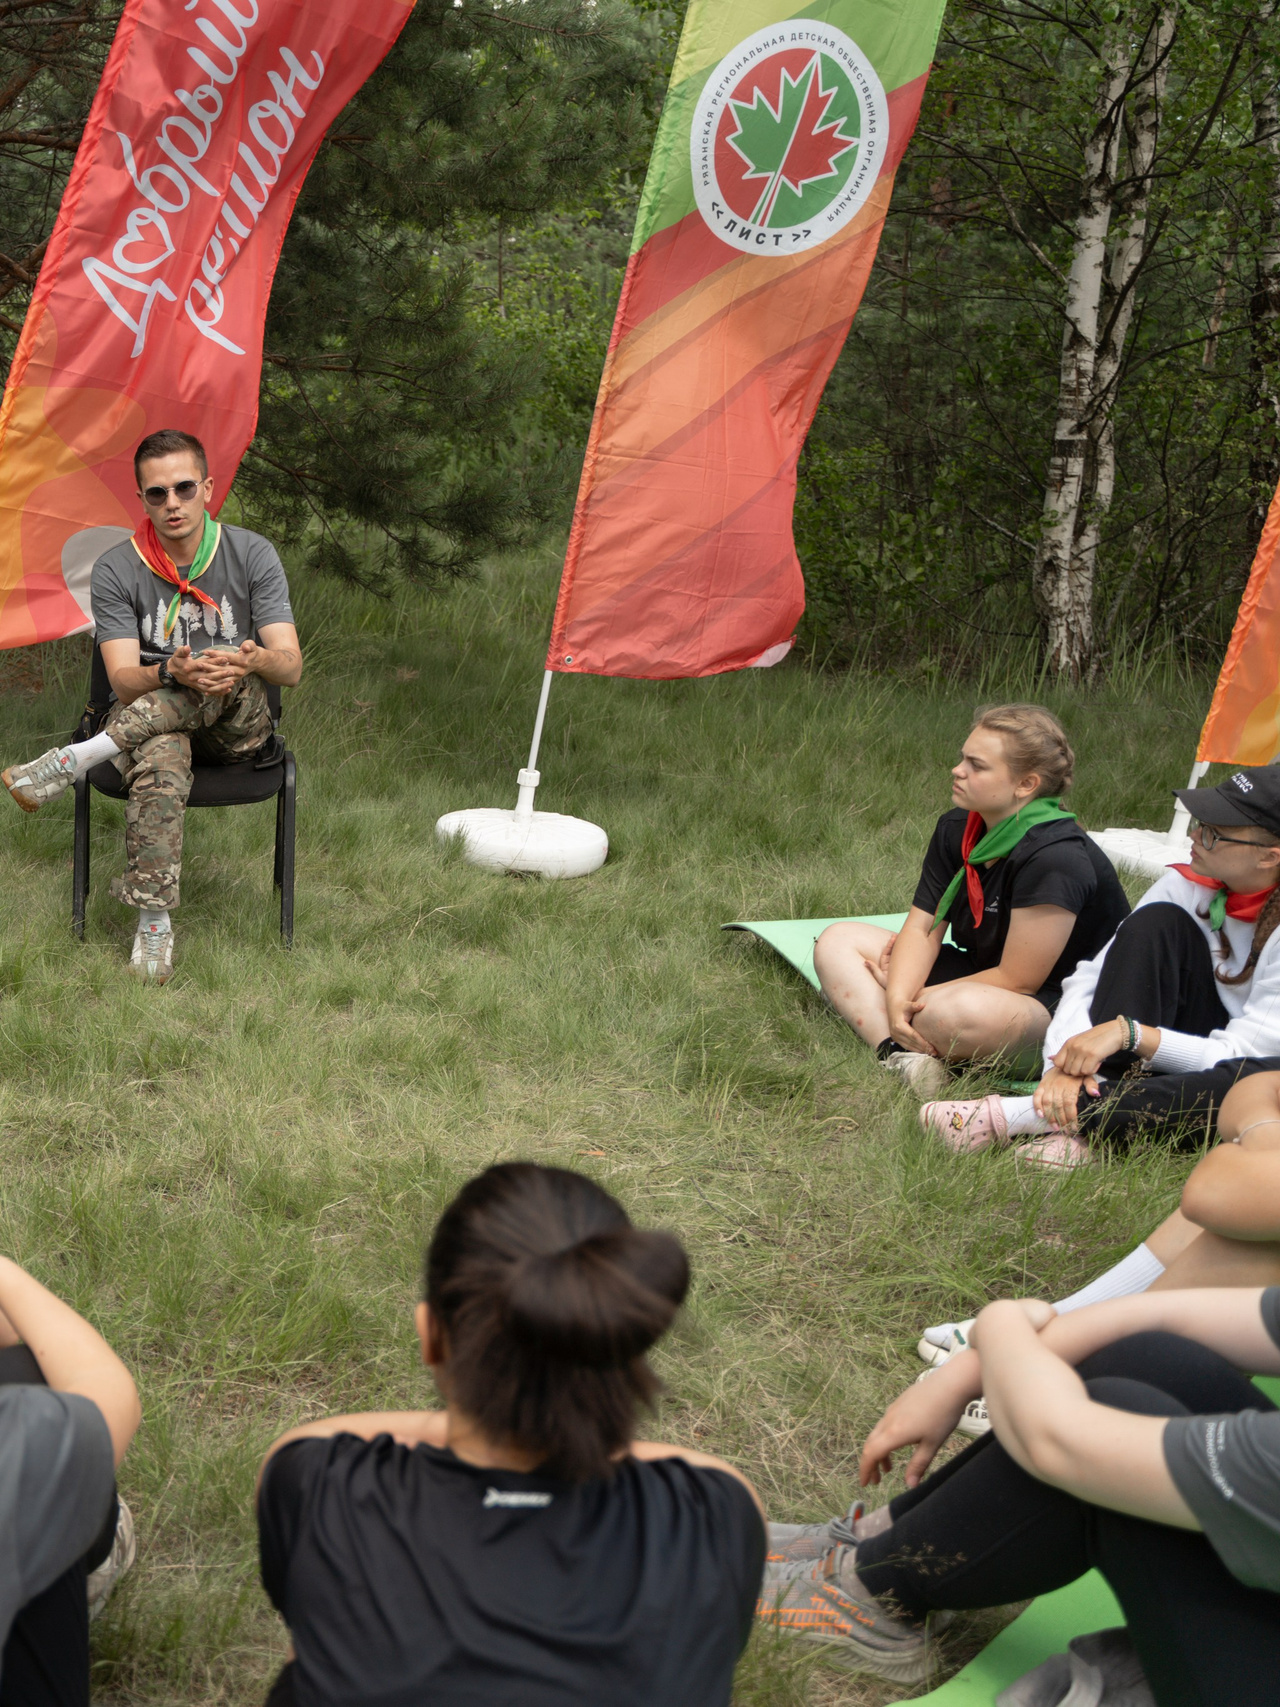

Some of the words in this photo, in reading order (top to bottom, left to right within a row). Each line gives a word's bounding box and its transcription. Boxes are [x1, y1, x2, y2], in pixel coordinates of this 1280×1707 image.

[711, 34, 786, 106] РЕГИОНАЛЬНАЯ
[790, 31, 837, 49] ДЕТСКАЯ
[837, 47, 876, 134] ОБЩЕСТВЕННАЯ
[701, 111, 715, 186] РЯЗАНСКАЯ
[826, 140, 875, 223] ОРГАНИЗАЦИЯ
